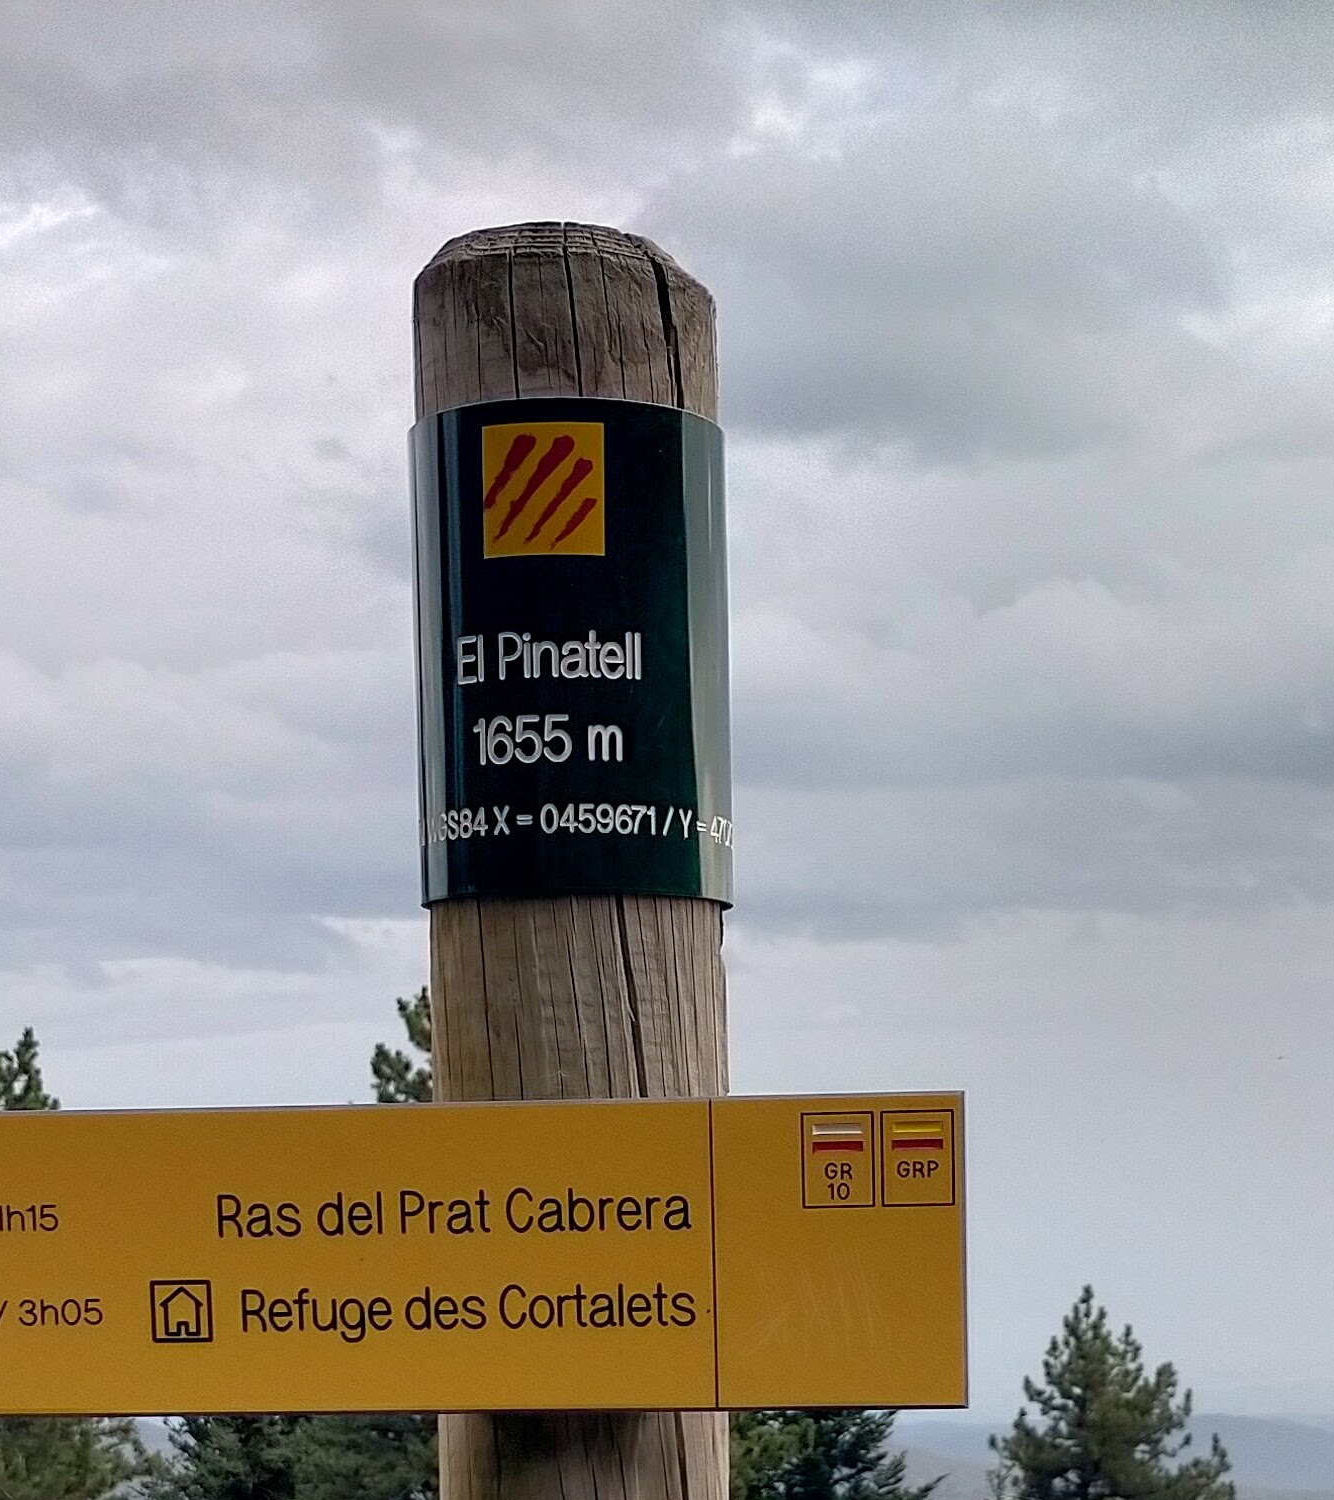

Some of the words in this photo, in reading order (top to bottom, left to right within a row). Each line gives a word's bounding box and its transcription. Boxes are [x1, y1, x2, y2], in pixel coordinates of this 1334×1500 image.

[456, 633, 485, 685] El
[497, 629, 643, 682] Pinatell
[472, 713, 573, 766] 1655
[587, 723, 624, 763] m
[492, 804, 511, 836] X
[515, 813, 534, 826] =
[539, 802, 657, 836] 0459671
[662, 805, 675, 837] /
[678, 807, 693, 841] Y
[824, 1162, 853, 1181] GR
[896, 1159, 940, 1179] GRP
[827, 1182, 851, 1201] 10
[216, 1194, 302, 1239] Ras
[316, 1190, 384, 1237] del
[399, 1188, 491, 1235] Prat
[505, 1187, 693, 1234] Cabrera
[18, 1298, 104, 1327] 3h05
[241, 1287, 393, 1344] Refuge
[404, 1285, 487, 1331] des
[498, 1282, 697, 1330] Cortalets
